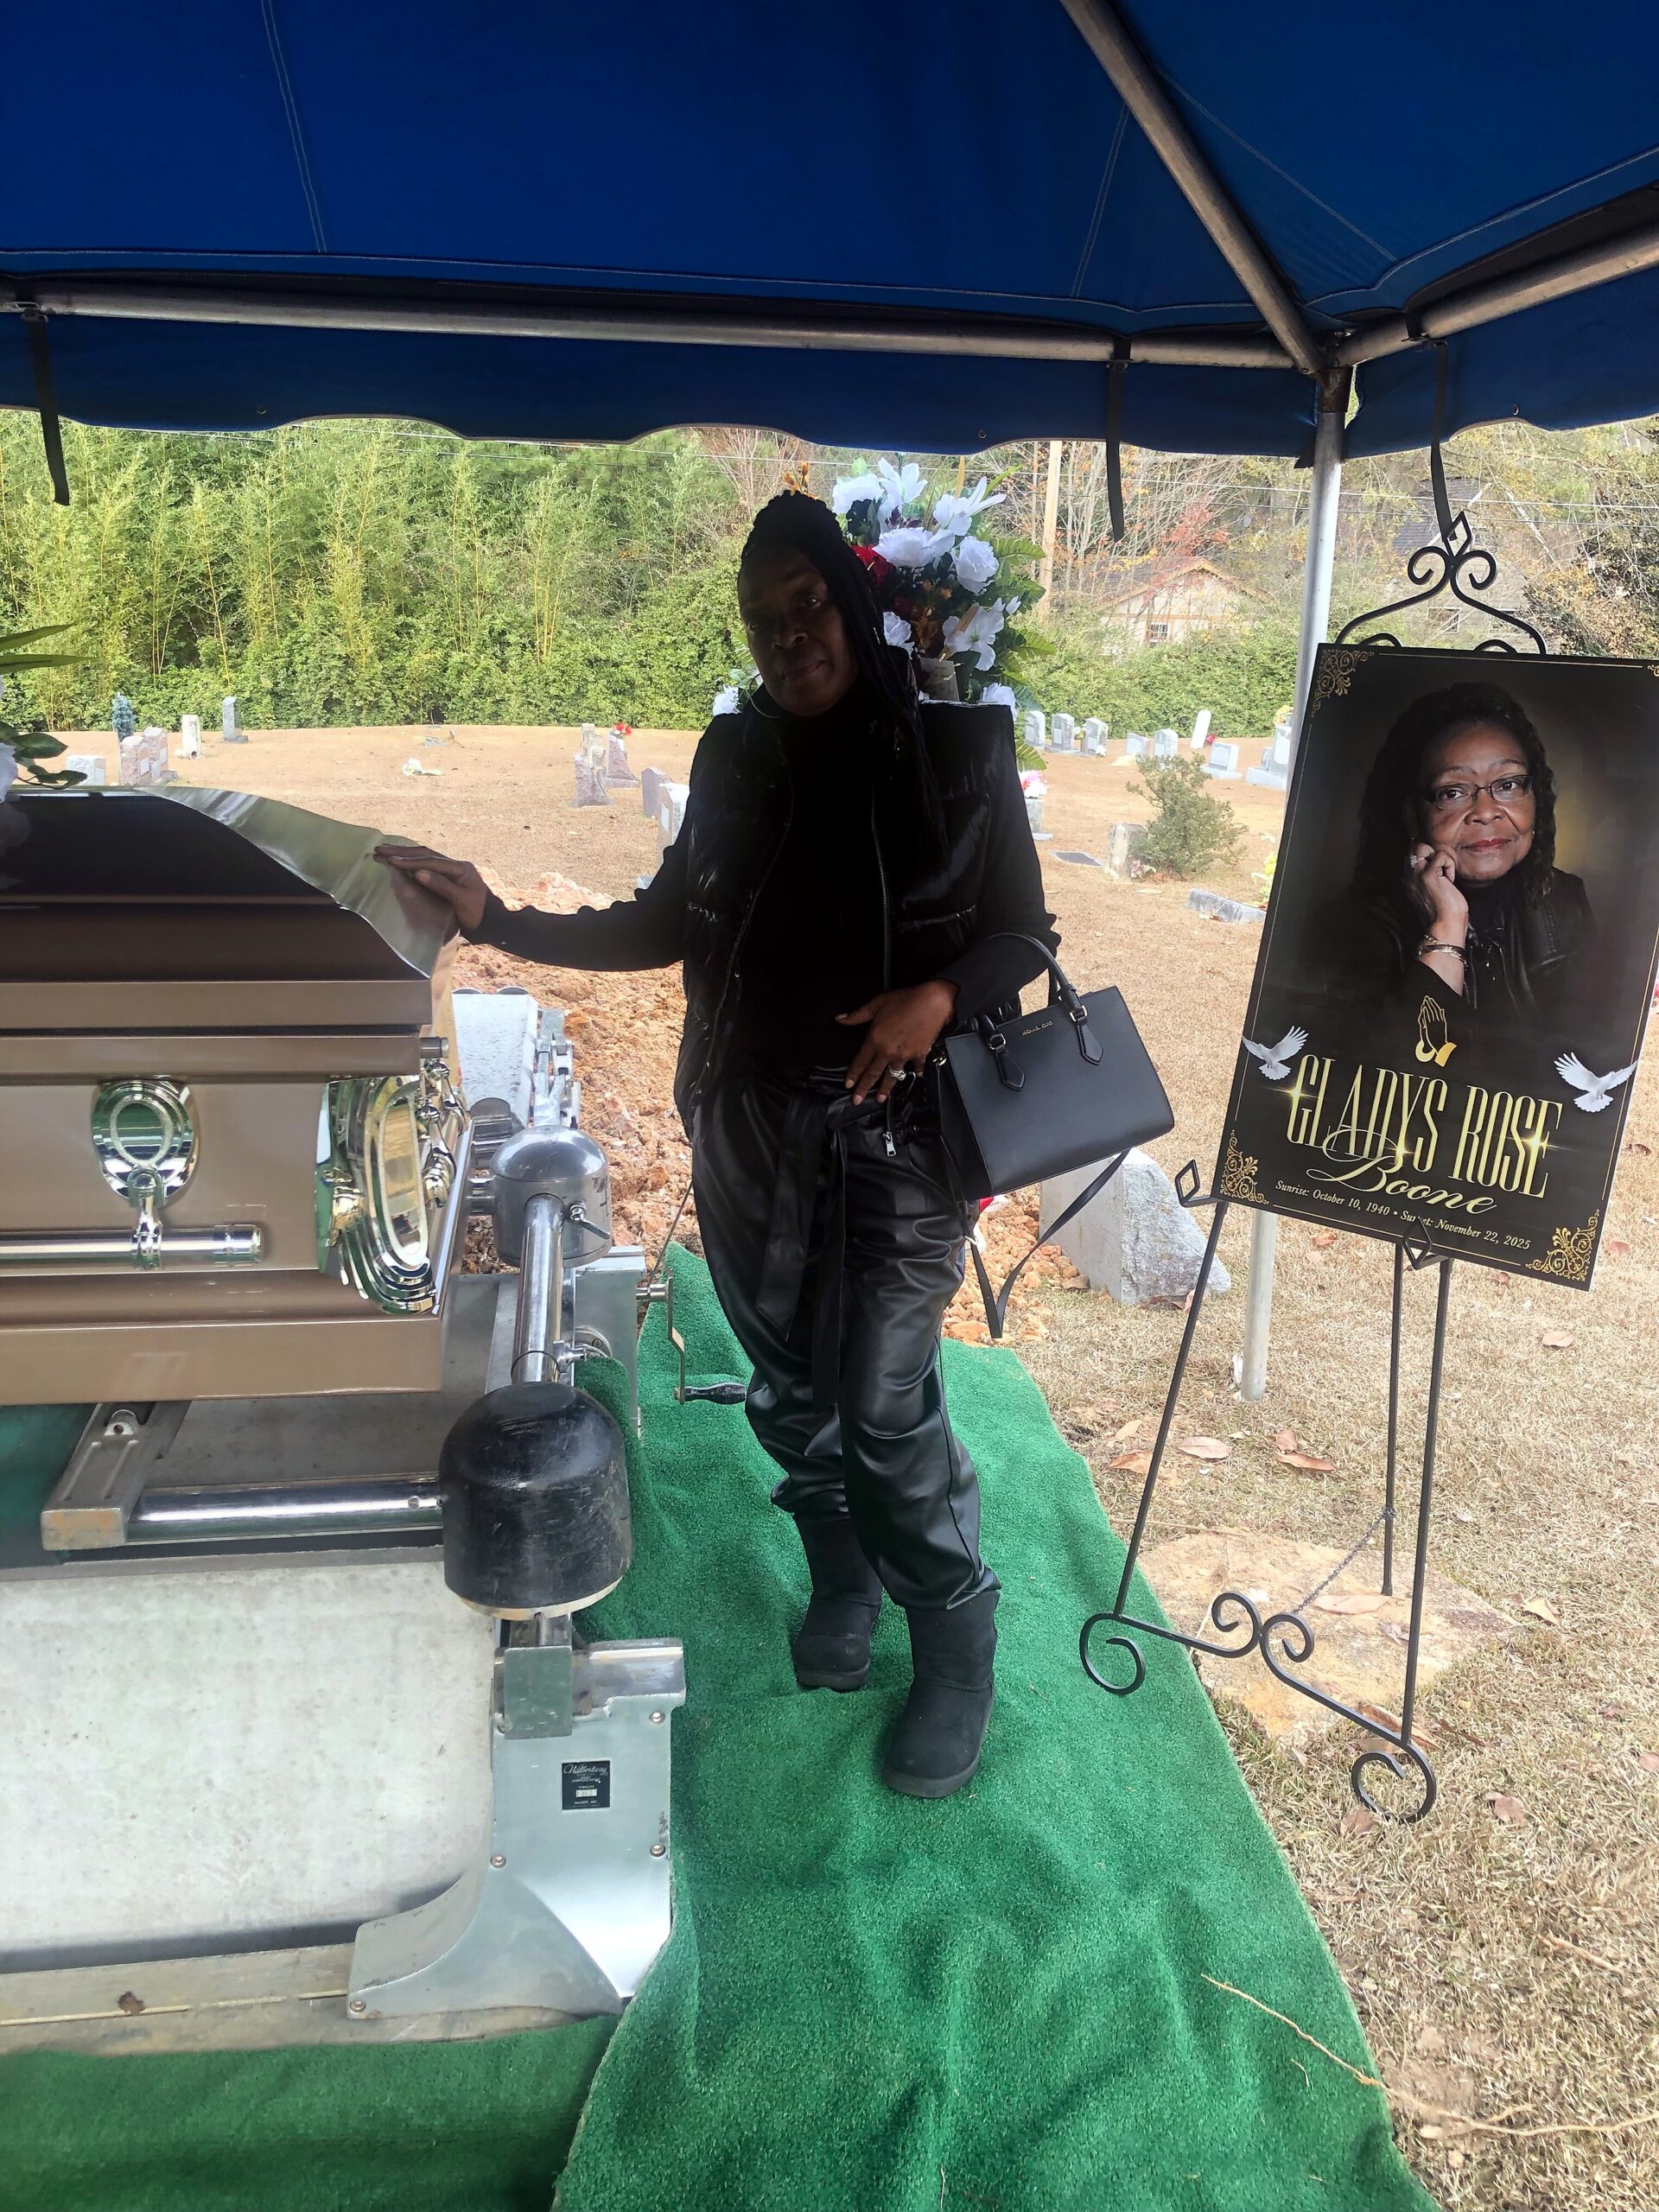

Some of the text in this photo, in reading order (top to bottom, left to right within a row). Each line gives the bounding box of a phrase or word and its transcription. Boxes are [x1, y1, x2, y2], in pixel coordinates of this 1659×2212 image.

[1287, 1054, 1563, 1198] GLADYS ROSE
[1275, 1179, 1310, 1197] Sunrise:
[1313, 1189, 1345, 1205] October
[1348, 1198, 1362, 1211] 10,
[1365, 1202, 1390, 1216] 1940
[1435, 1218, 1482, 1238] November
[1484, 1230, 1499, 1244] 22,
[1503, 1235, 1532, 1250] 2025
[1306, 1128, 1497, 1215] Boone
